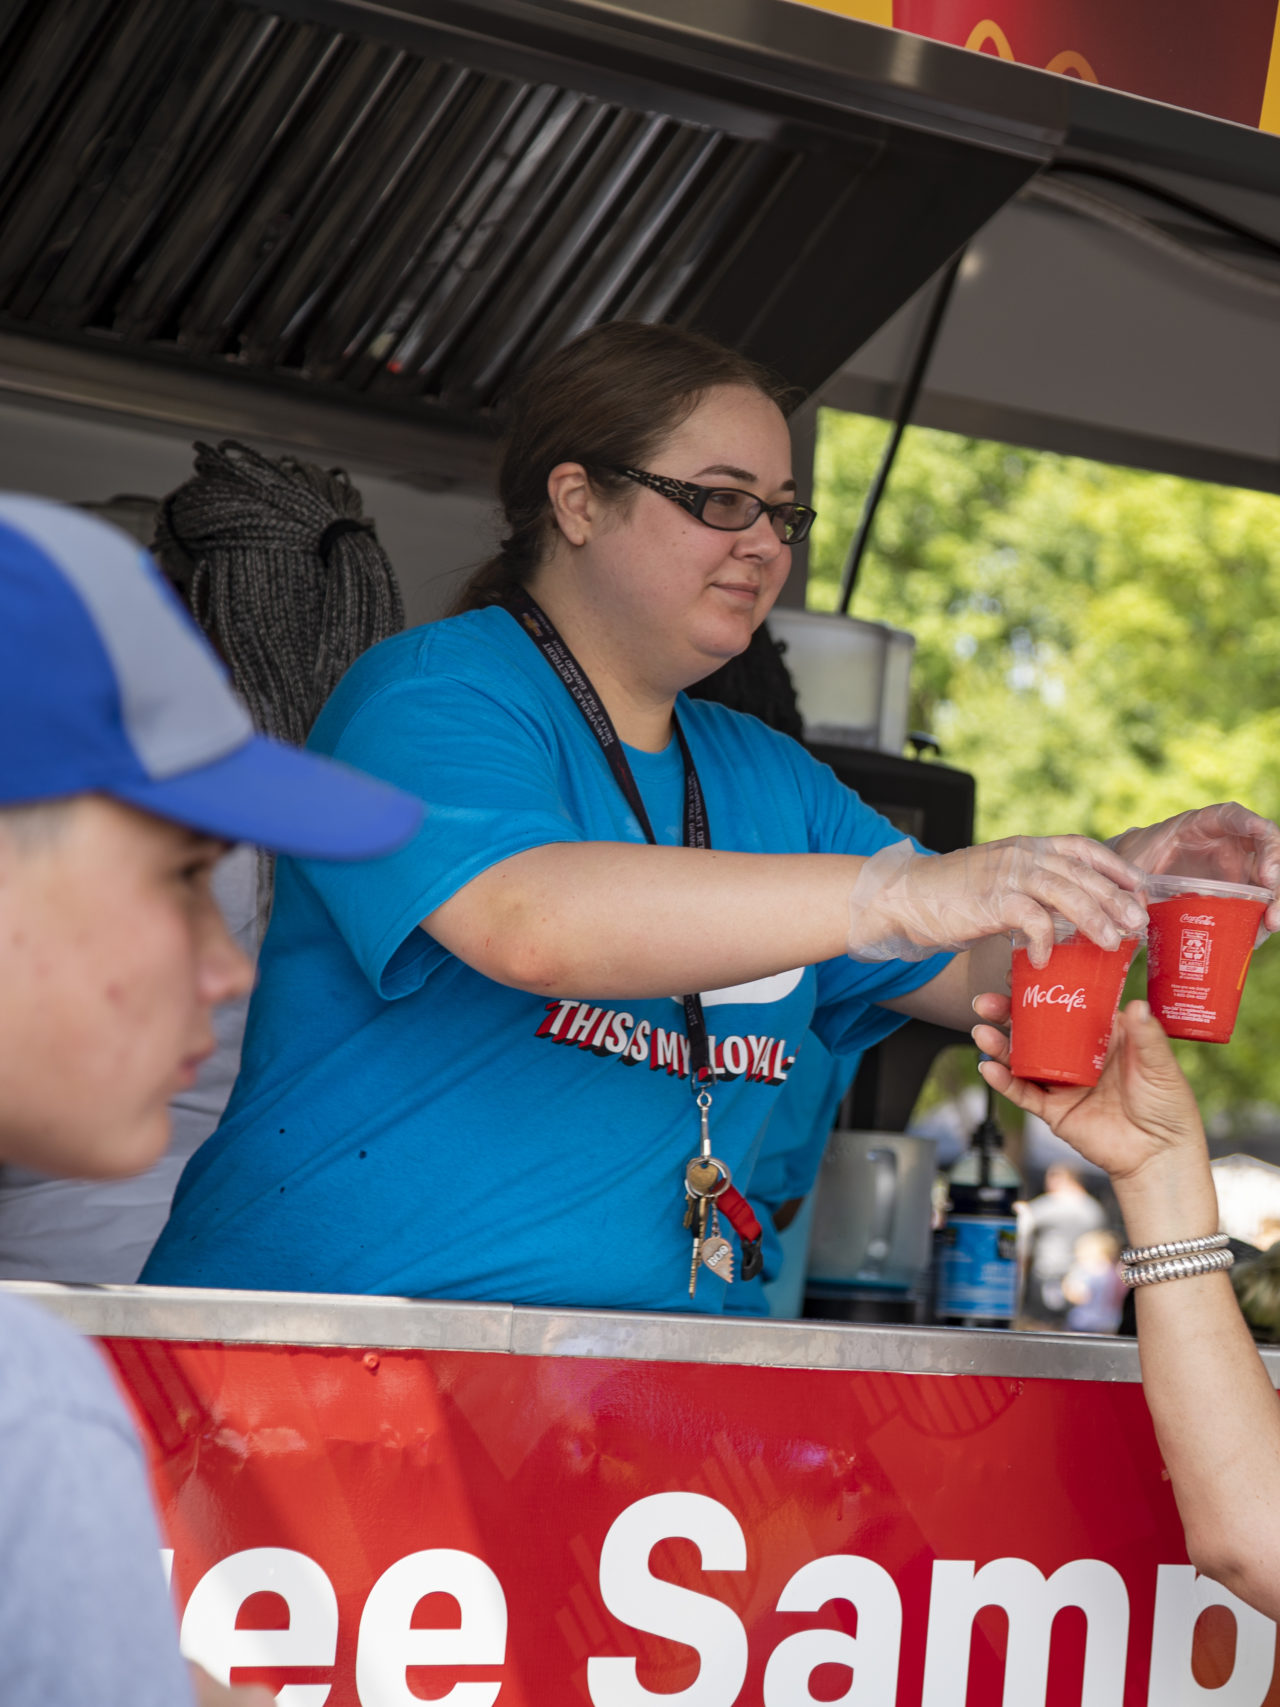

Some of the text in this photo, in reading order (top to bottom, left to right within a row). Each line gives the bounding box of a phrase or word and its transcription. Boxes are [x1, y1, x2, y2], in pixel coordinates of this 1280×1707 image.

[542, 642, 572, 684] DETROIT
[551, 639, 614, 744] BELLE ISLE GRAND PRIX
[571, 686, 609, 747] CHEVROLET
[1022, 984, 1085, 1013] McCafé
[537, 1000, 633, 1056] THIS
[651, 1027, 691, 1078] MY
[159, 1545, 508, 1707] ee
